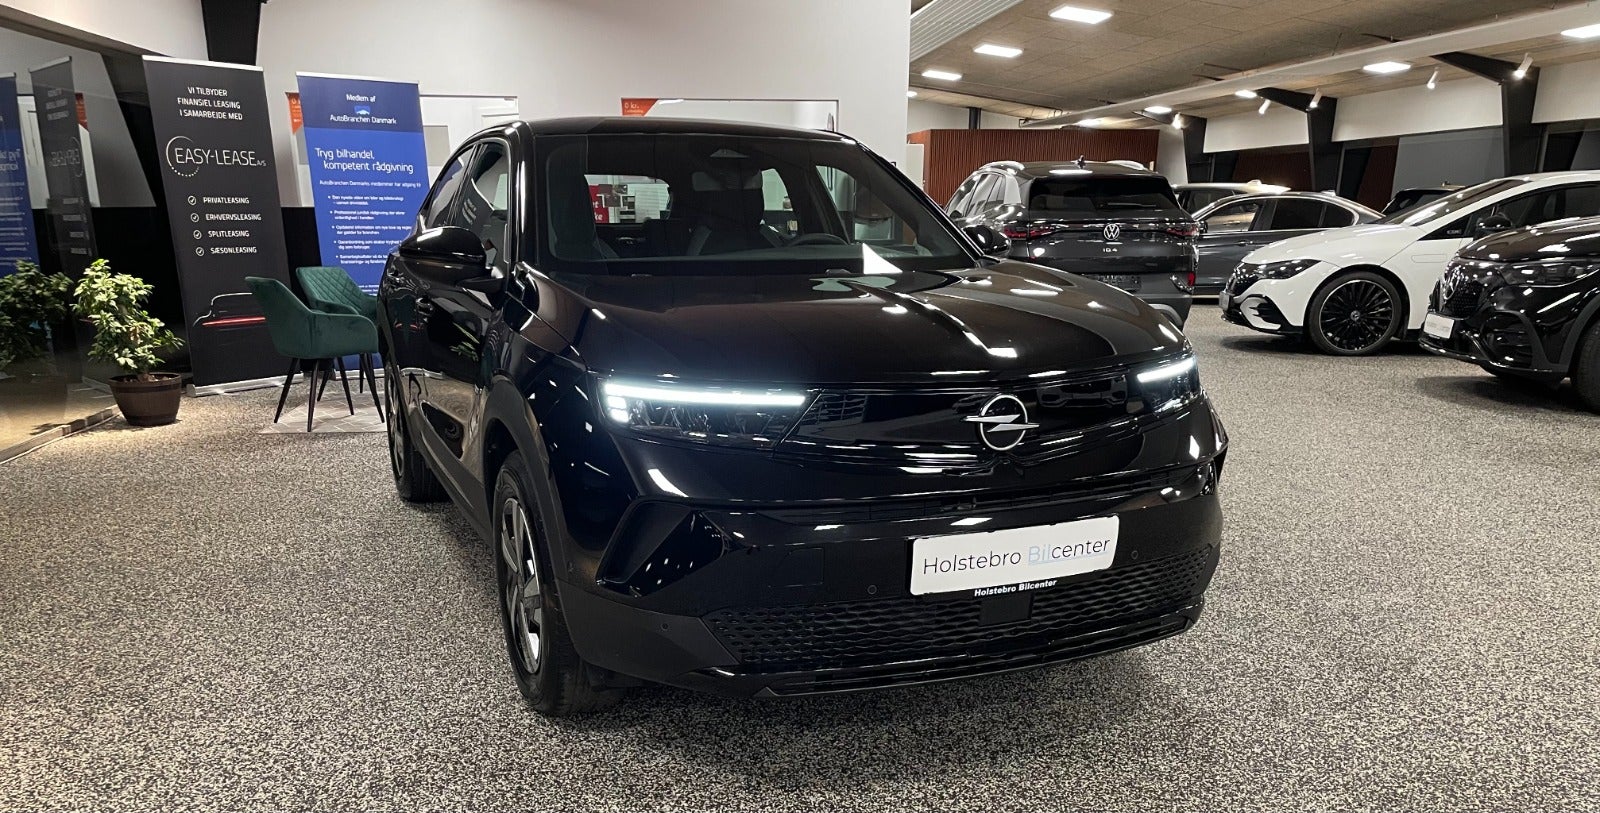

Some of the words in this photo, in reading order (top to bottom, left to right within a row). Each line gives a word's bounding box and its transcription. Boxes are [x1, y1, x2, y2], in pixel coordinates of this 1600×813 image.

[196, 87, 228, 96] TILBYDER
[177, 98, 212, 106] FINANSIEL
[214, 100, 240, 108] LEASING
[183, 109, 226, 118] SAMARBEJDE
[174, 148, 256, 166] EASY-LEASE
[314, 147, 334, 161] Tryg
[336, 149, 374, 160] bilhandel,
[323, 161, 370, 172] kompetent
[372, 161, 414, 175] rådgivning
[923, 550, 1022, 576] Holstebro
[1028, 538, 1110, 563] Bilcenter
[974, 583, 1017, 597] Holstebro
[1019, 579, 1057, 592] Bilcenter
